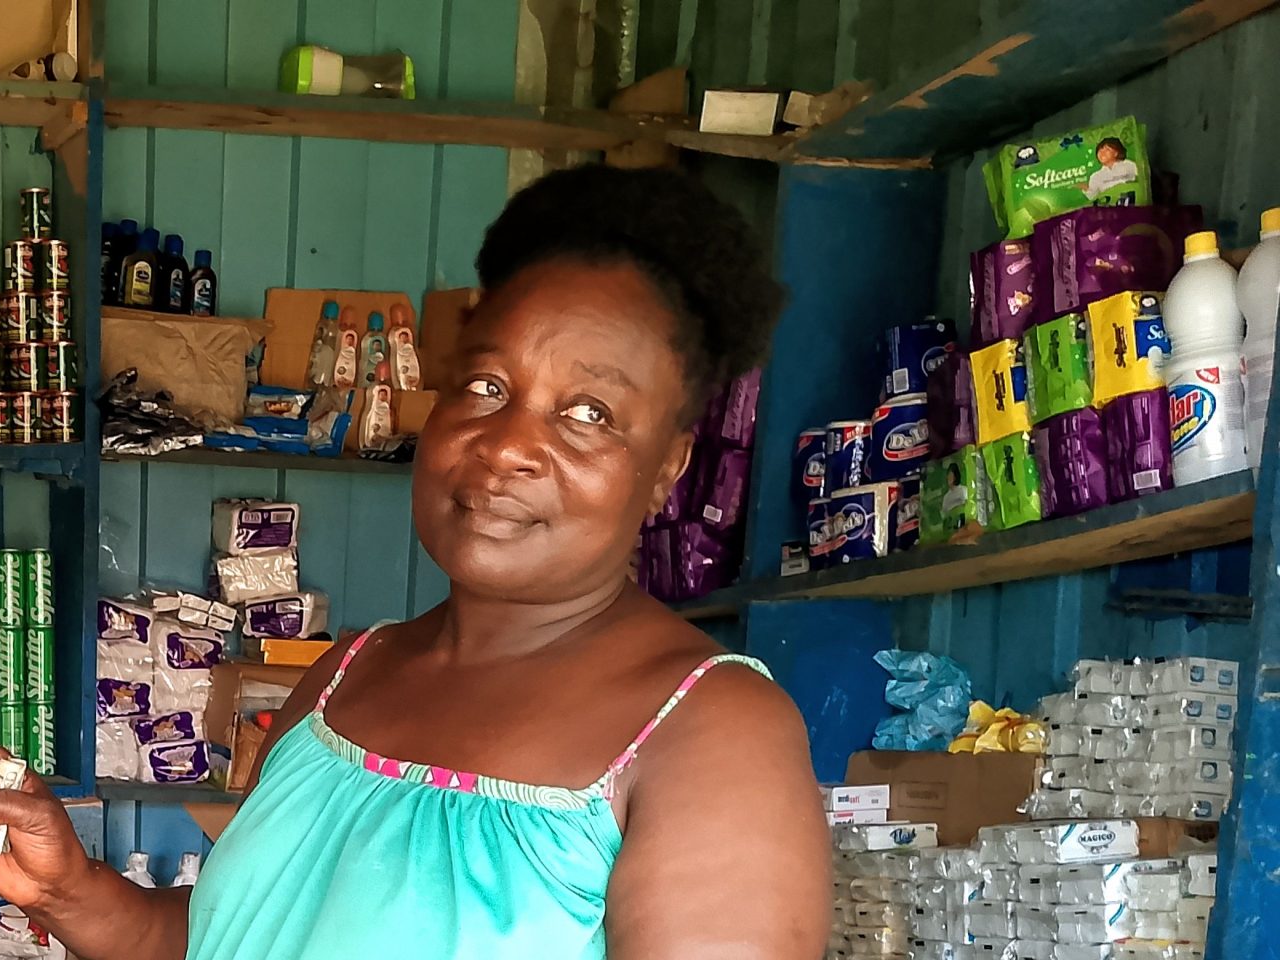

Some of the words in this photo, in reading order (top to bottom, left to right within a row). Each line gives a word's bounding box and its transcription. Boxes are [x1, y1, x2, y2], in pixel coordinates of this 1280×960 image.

[1023, 165, 1087, 190] Softcare
[30, 551, 55, 625] Sprite
[26, 628, 49, 699] Sprite
[33, 705, 56, 776] Sprite
[1080, 832, 1113, 843] MAGICO
